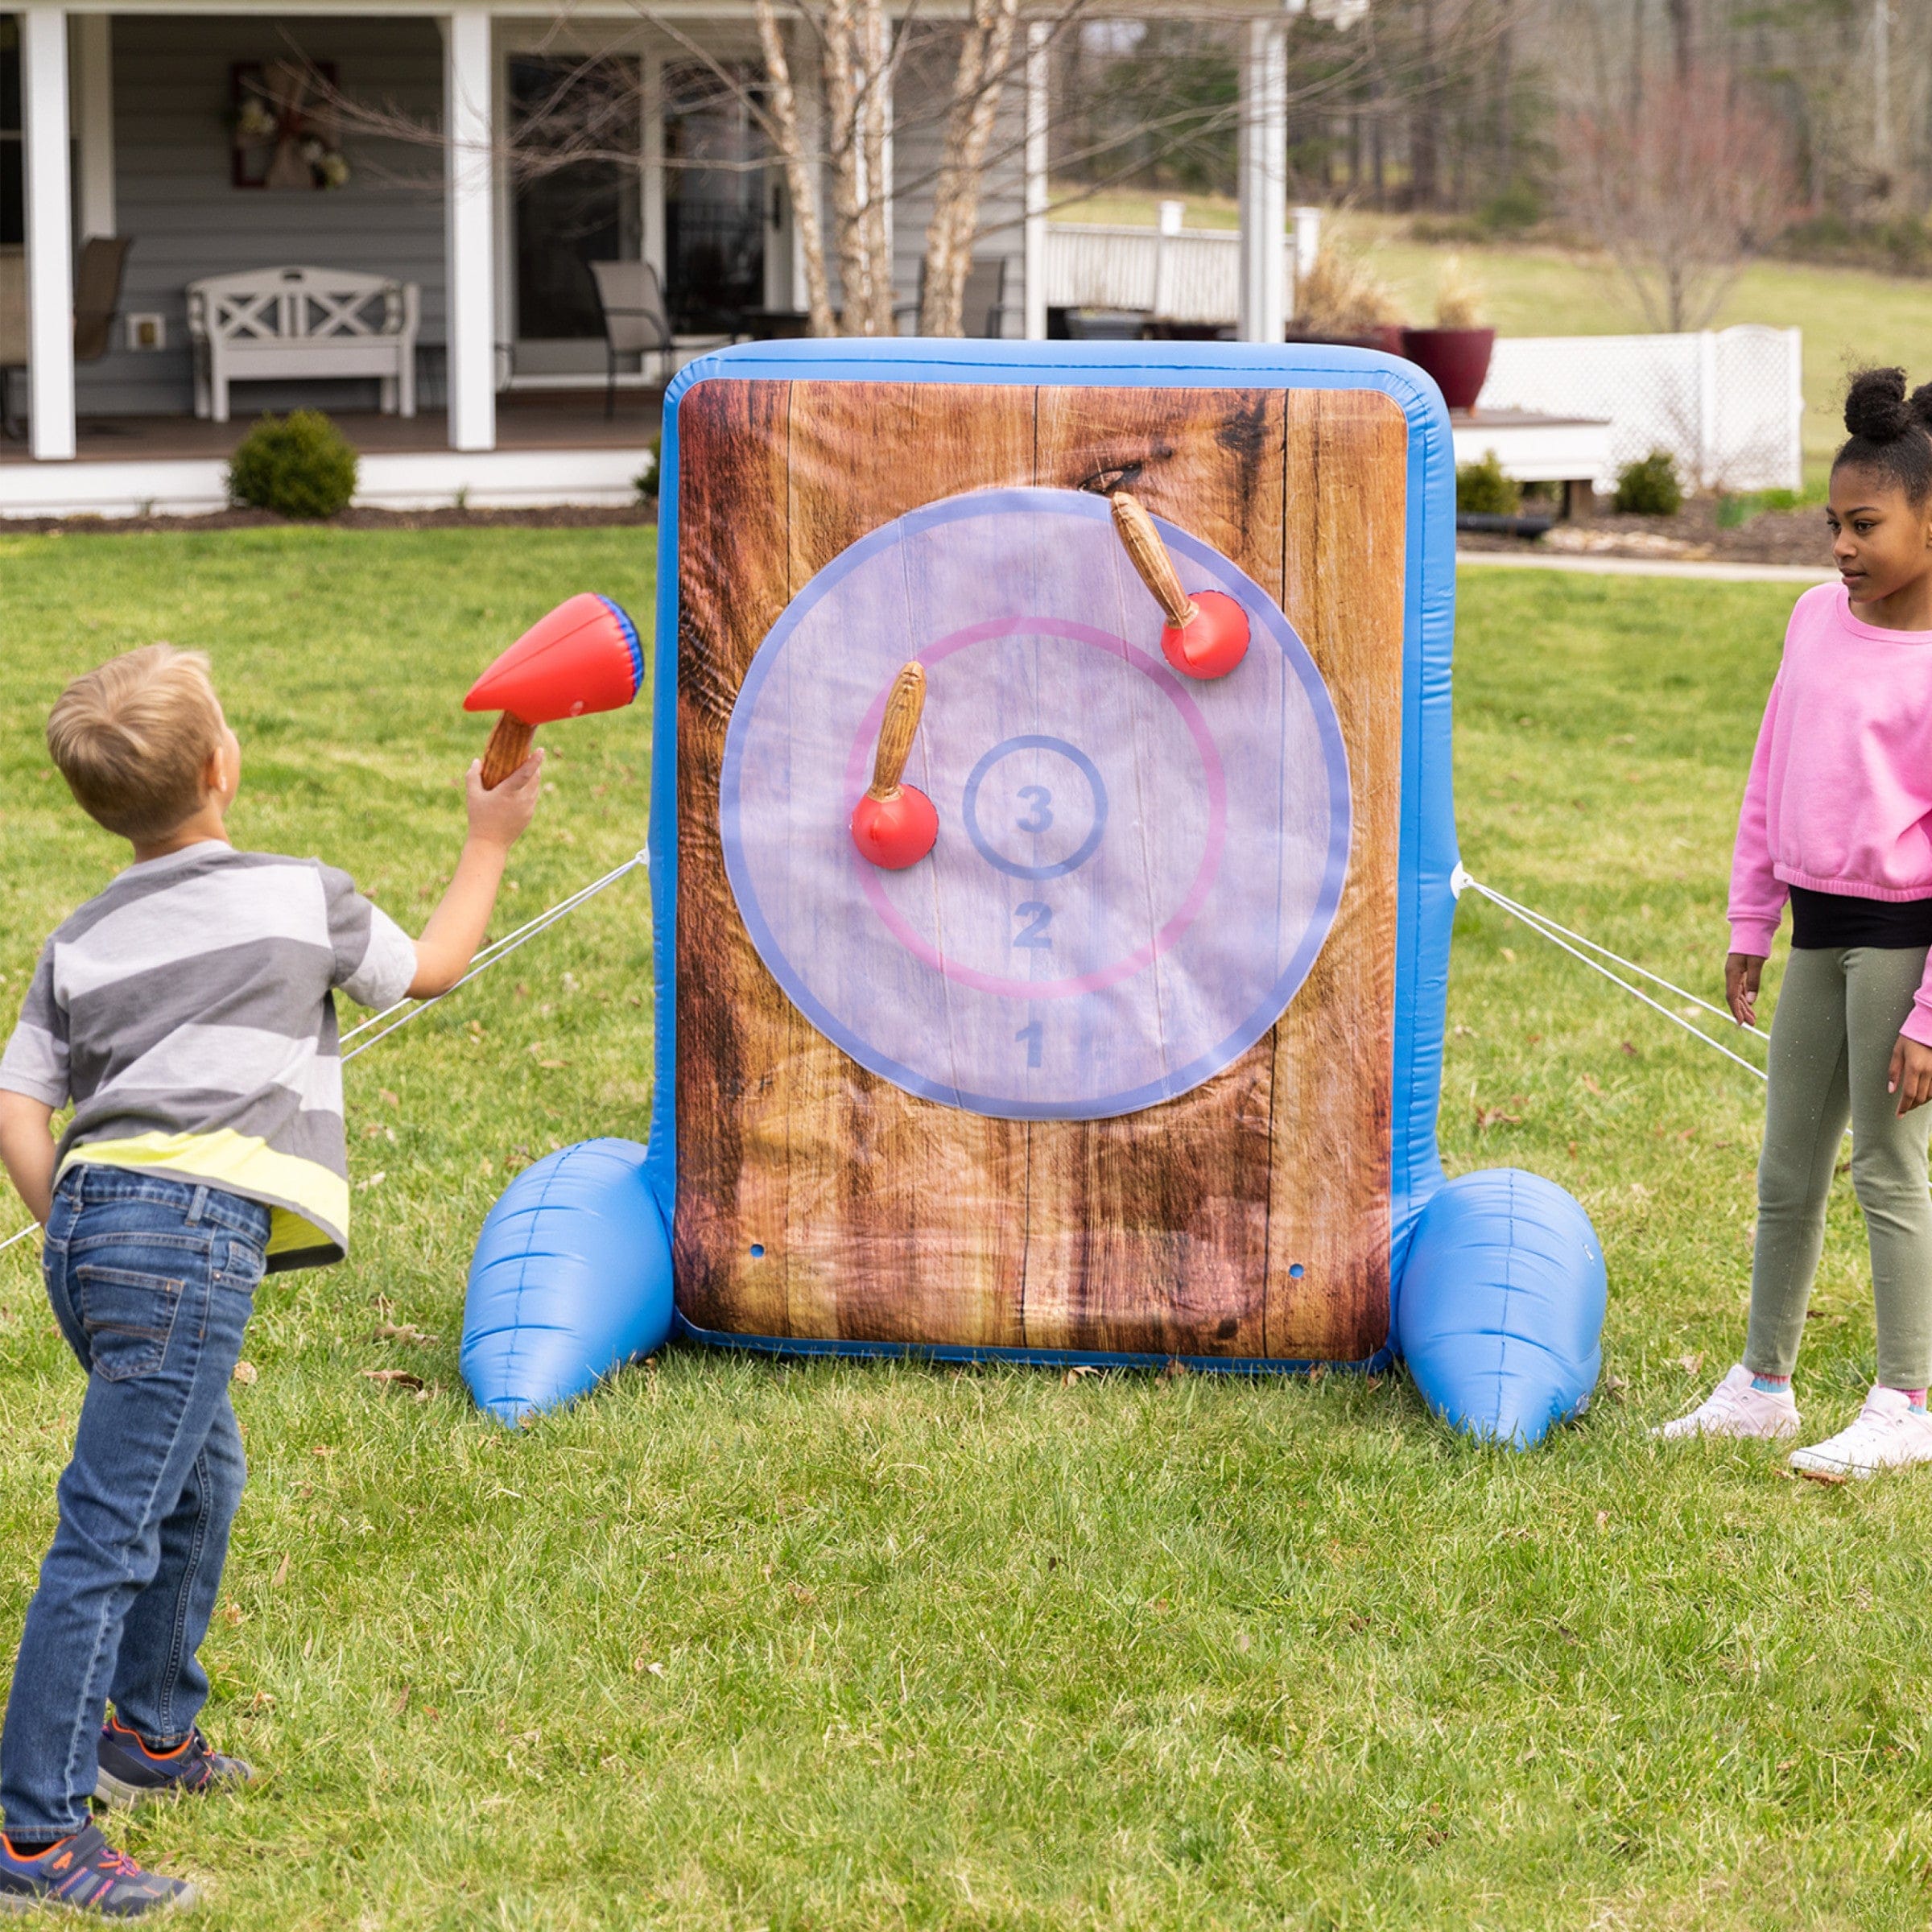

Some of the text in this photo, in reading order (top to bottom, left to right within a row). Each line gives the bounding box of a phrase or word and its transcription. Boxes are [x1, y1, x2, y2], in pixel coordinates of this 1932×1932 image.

[1016, 785, 1054, 833] 3
[1013, 901, 1053, 948] 2
[1015, 1021, 1043, 1067] 1
